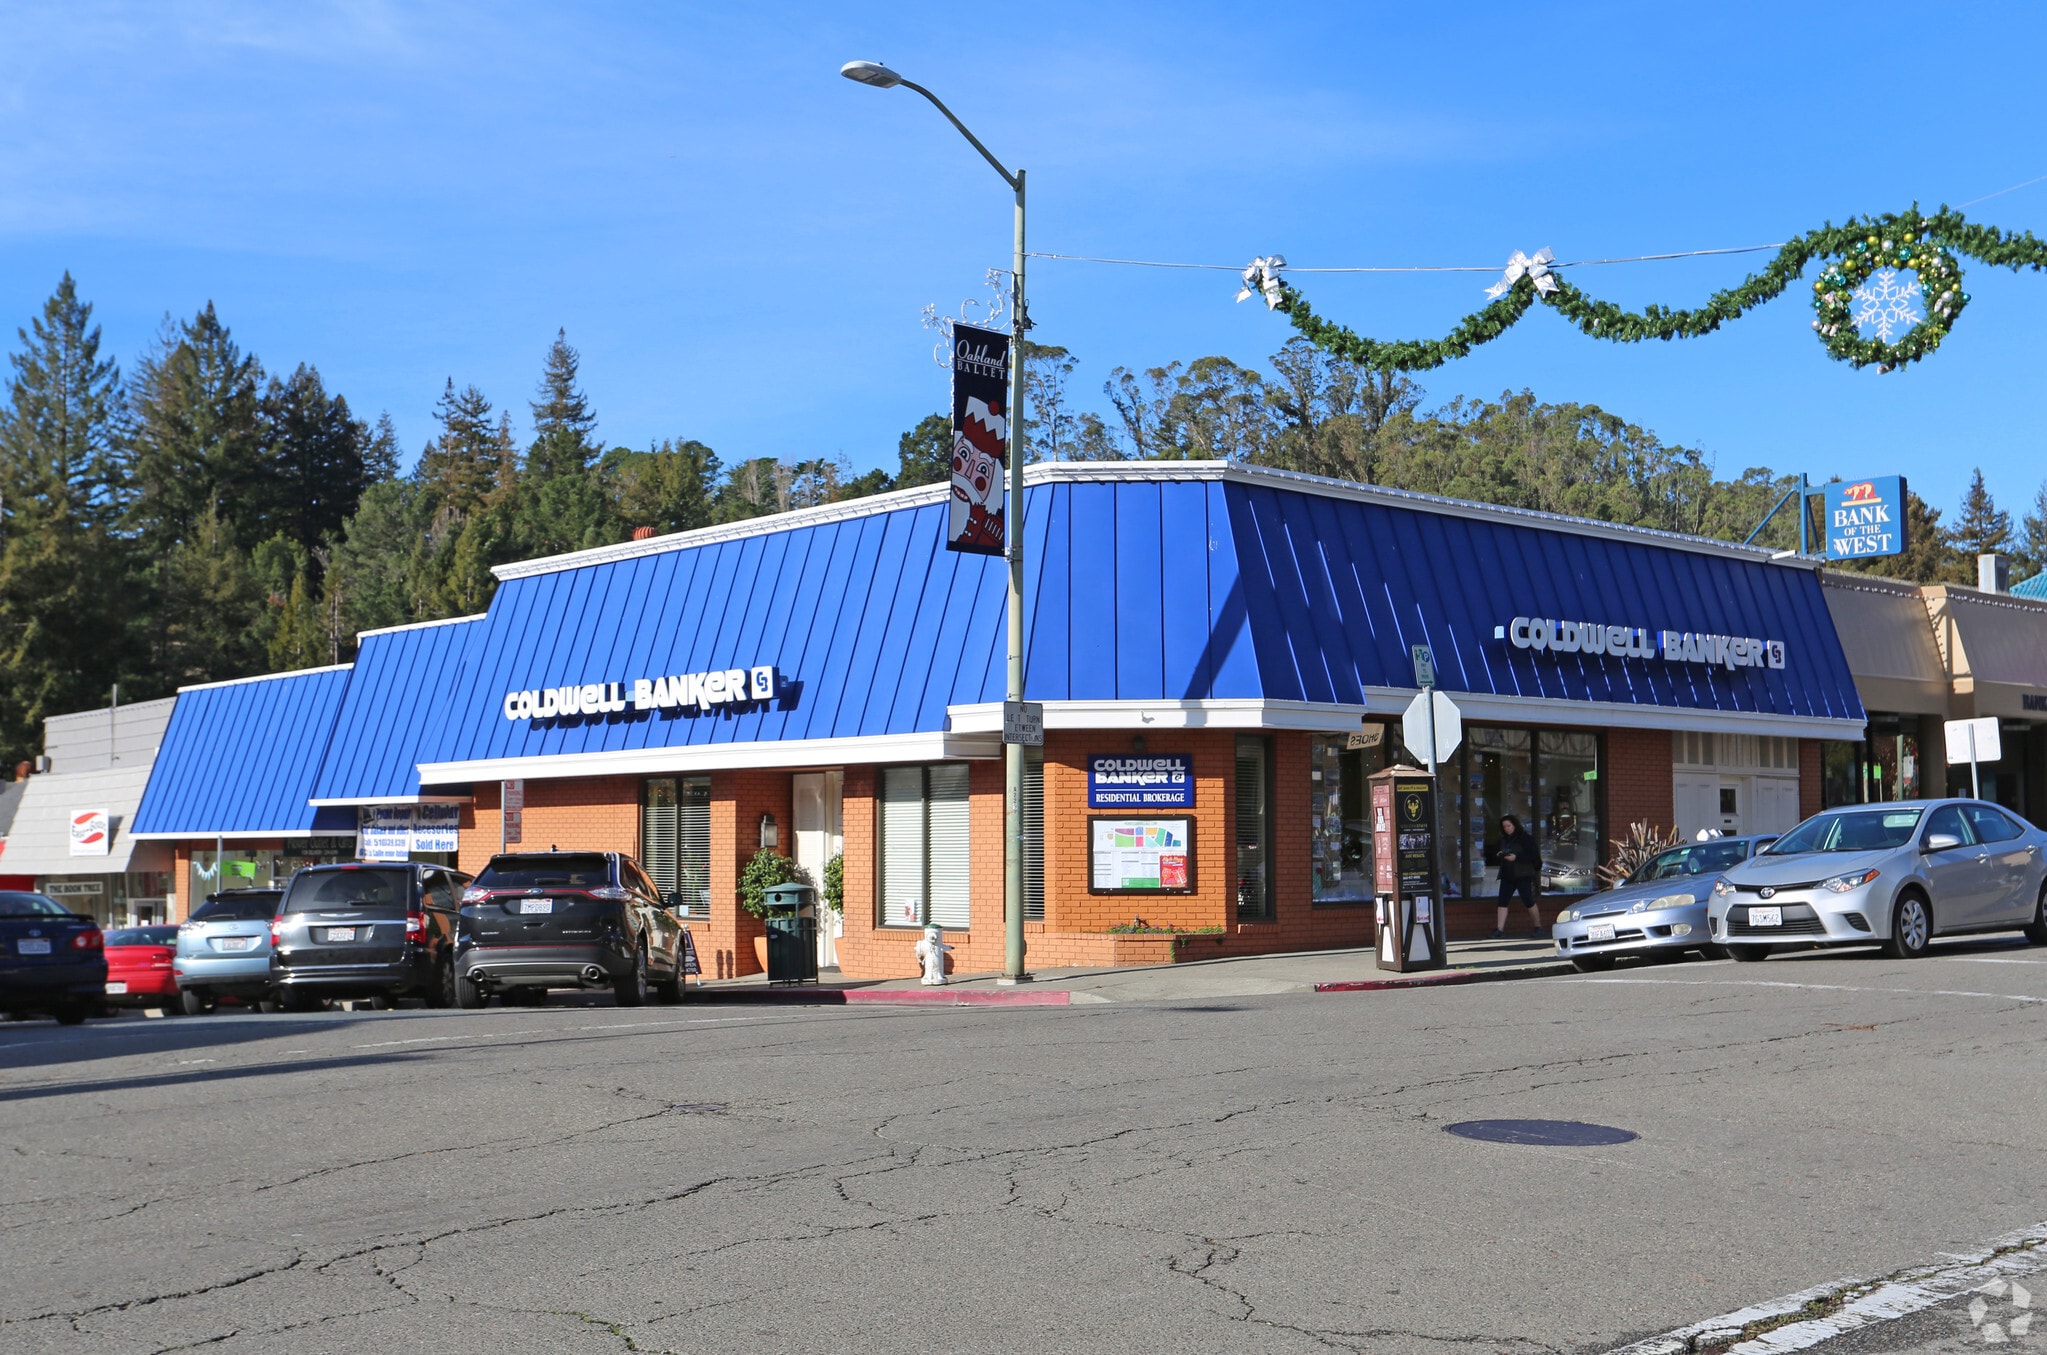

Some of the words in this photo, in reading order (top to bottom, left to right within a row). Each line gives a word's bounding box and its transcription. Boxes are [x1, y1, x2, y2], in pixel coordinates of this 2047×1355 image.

[957, 339, 1006, 367] Oakland
[957, 360, 1006, 380] BALLET
[1834, 505, 1891, 527] BANK
[1844, 527, 1857, 536] OF
[1860, 524, 1881, 535] THE
[1833, 533, 1892, 556] WEST
[1511, 616, 1655, 660] COLDWELL
[1664, 629, 1765, 671] BANKER
[504, 681, 626, 721] COLDWELL
[634, 668, 747, 710] BANKER
[1020, 705, 1027, 713] NO
[1007, 714, 1020, 722] LET
[1026, 714, 1040, 723] TURN
[1015, 724, 1036, 733] ETWEEN
[1094, 759, 1186, 771] COLDWELL
[1095, 772, 1168, 786] BANKER
[1096, 793, 1141, 802] RESIDENTIAL
[1143, 793, 1185, 802] BROKERAGE
[422, 804, 458, 820] Cellular
[415, 839, 433, 850] Sold
[435, 839, 454, 850] Here
[49, 885, 63, 894] THE
